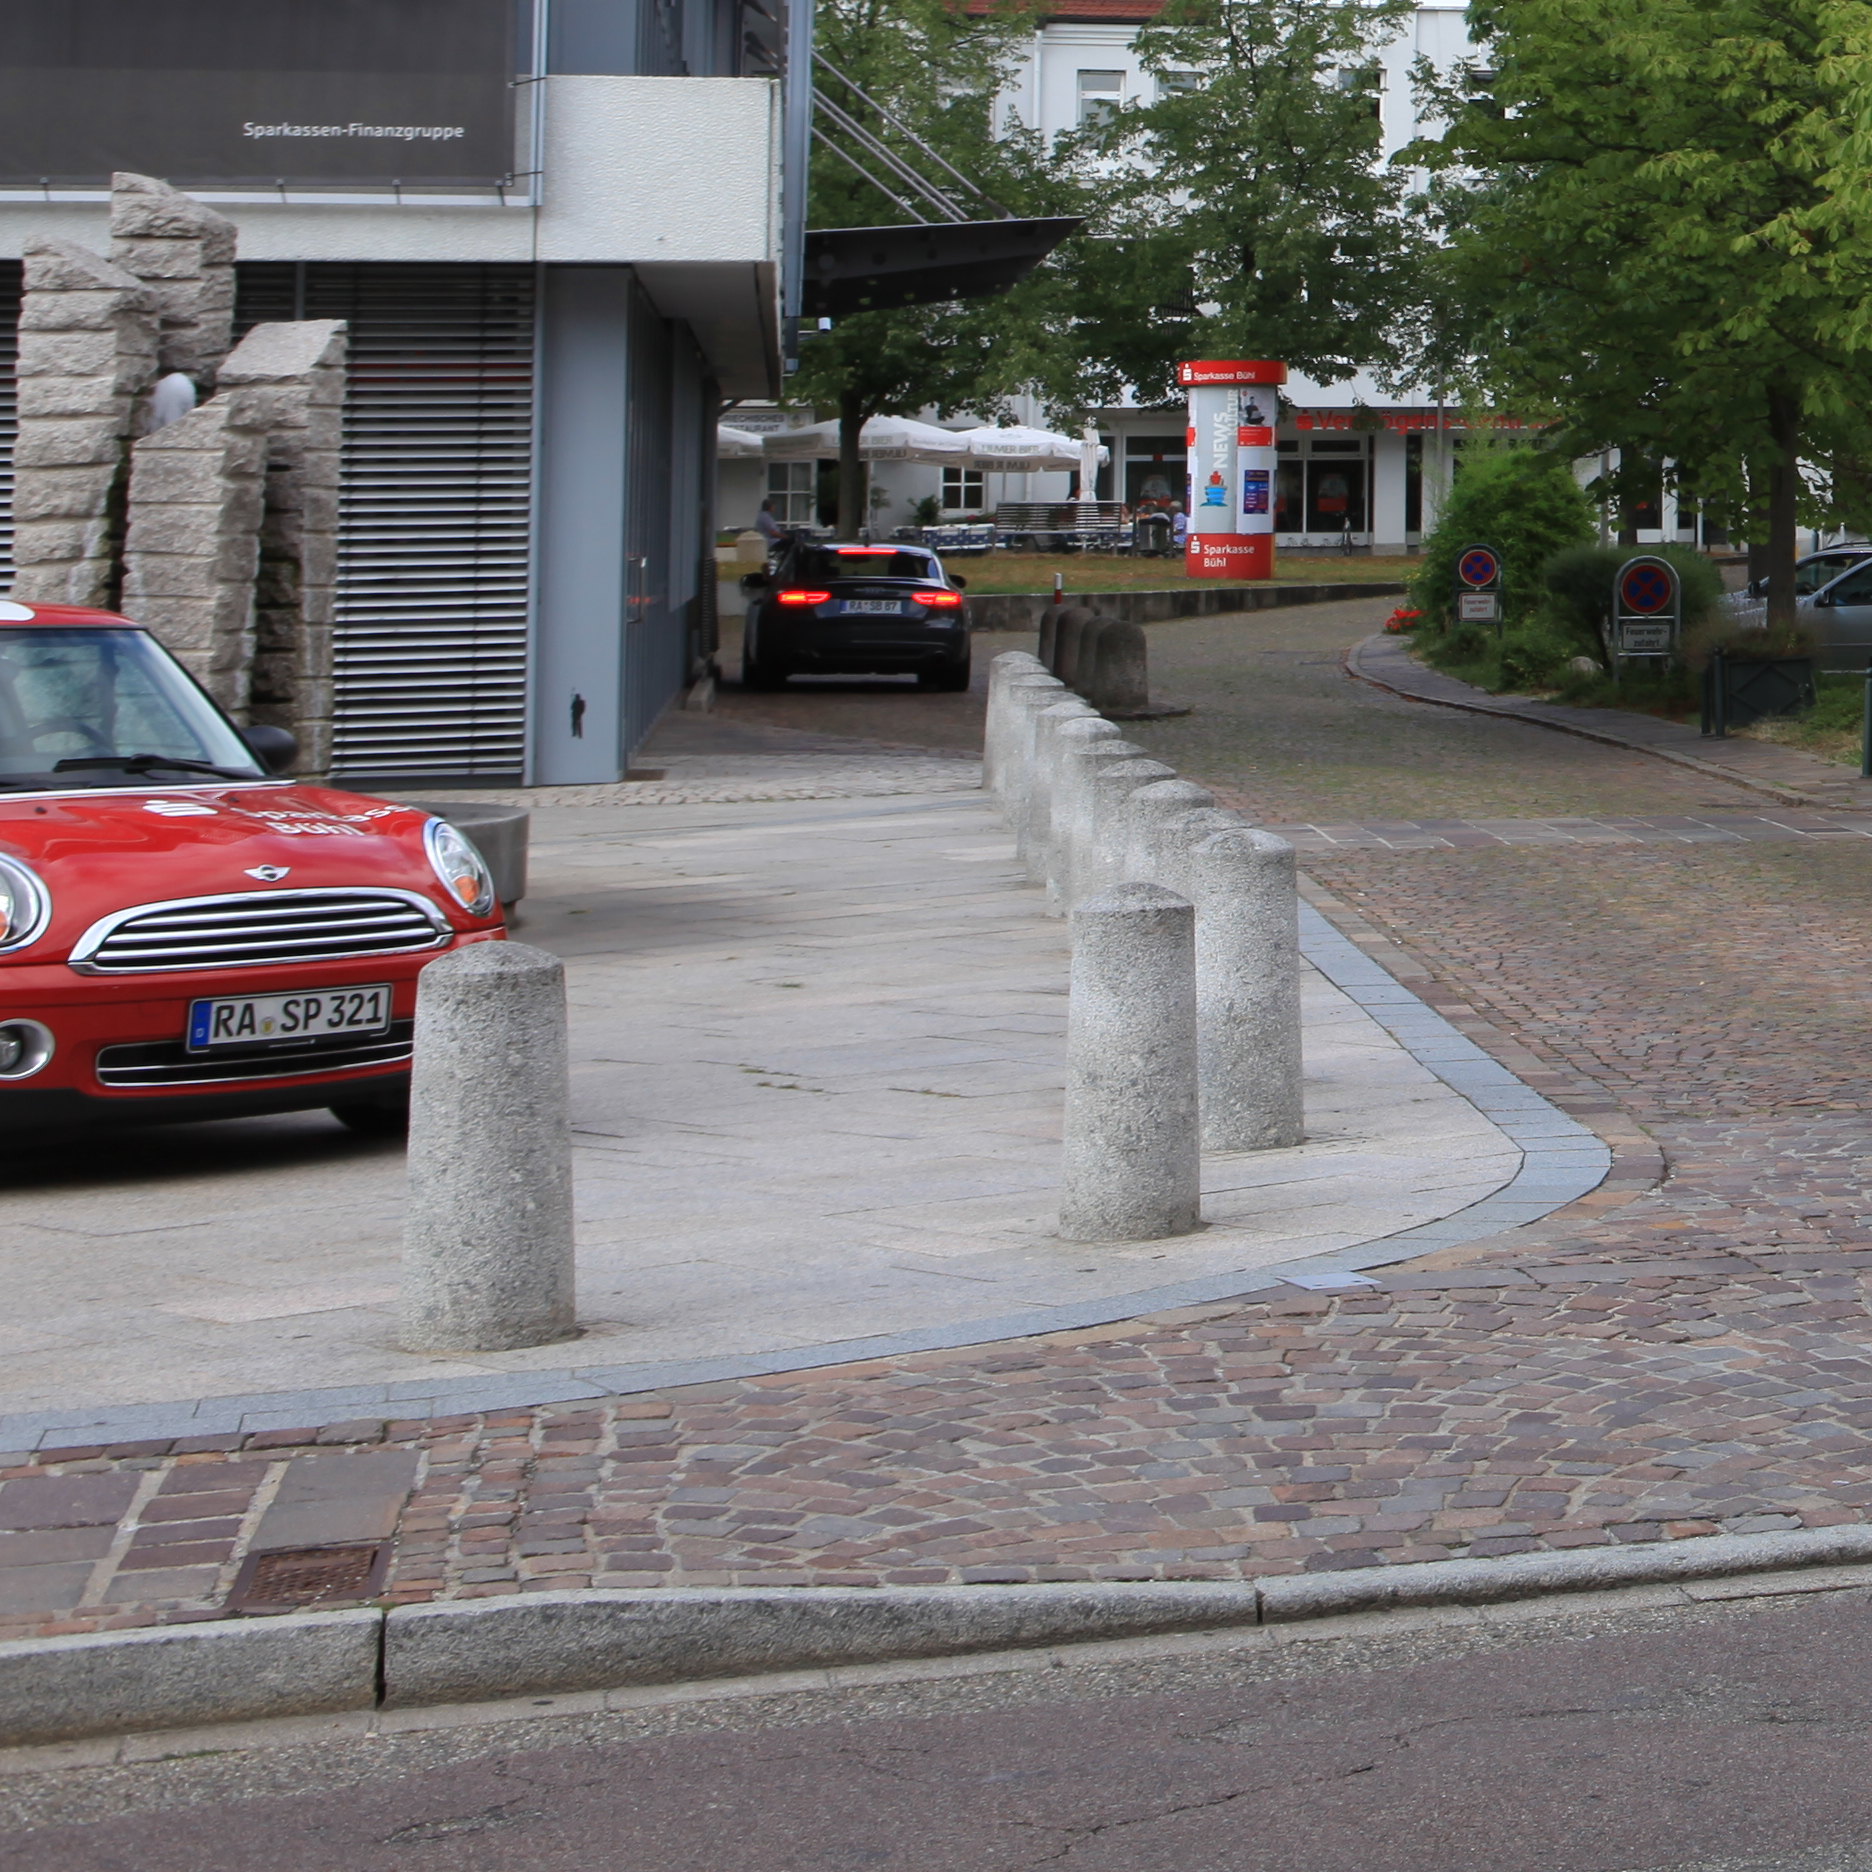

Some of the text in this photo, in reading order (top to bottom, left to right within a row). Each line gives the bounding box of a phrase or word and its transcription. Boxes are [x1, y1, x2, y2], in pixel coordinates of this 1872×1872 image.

[242, 121, 466, 142] Sparkassen-Finanzgruppe
[1193, 370, 1256, 381] Sparkasse Bühl
[1213, 412, 1229, 469] NEWS
[1203, 544, 1256, 556] Sparkasse
[1203, 557, 1227, 568] Bühl
[212, 991, 383, 1038] RA SP 321
